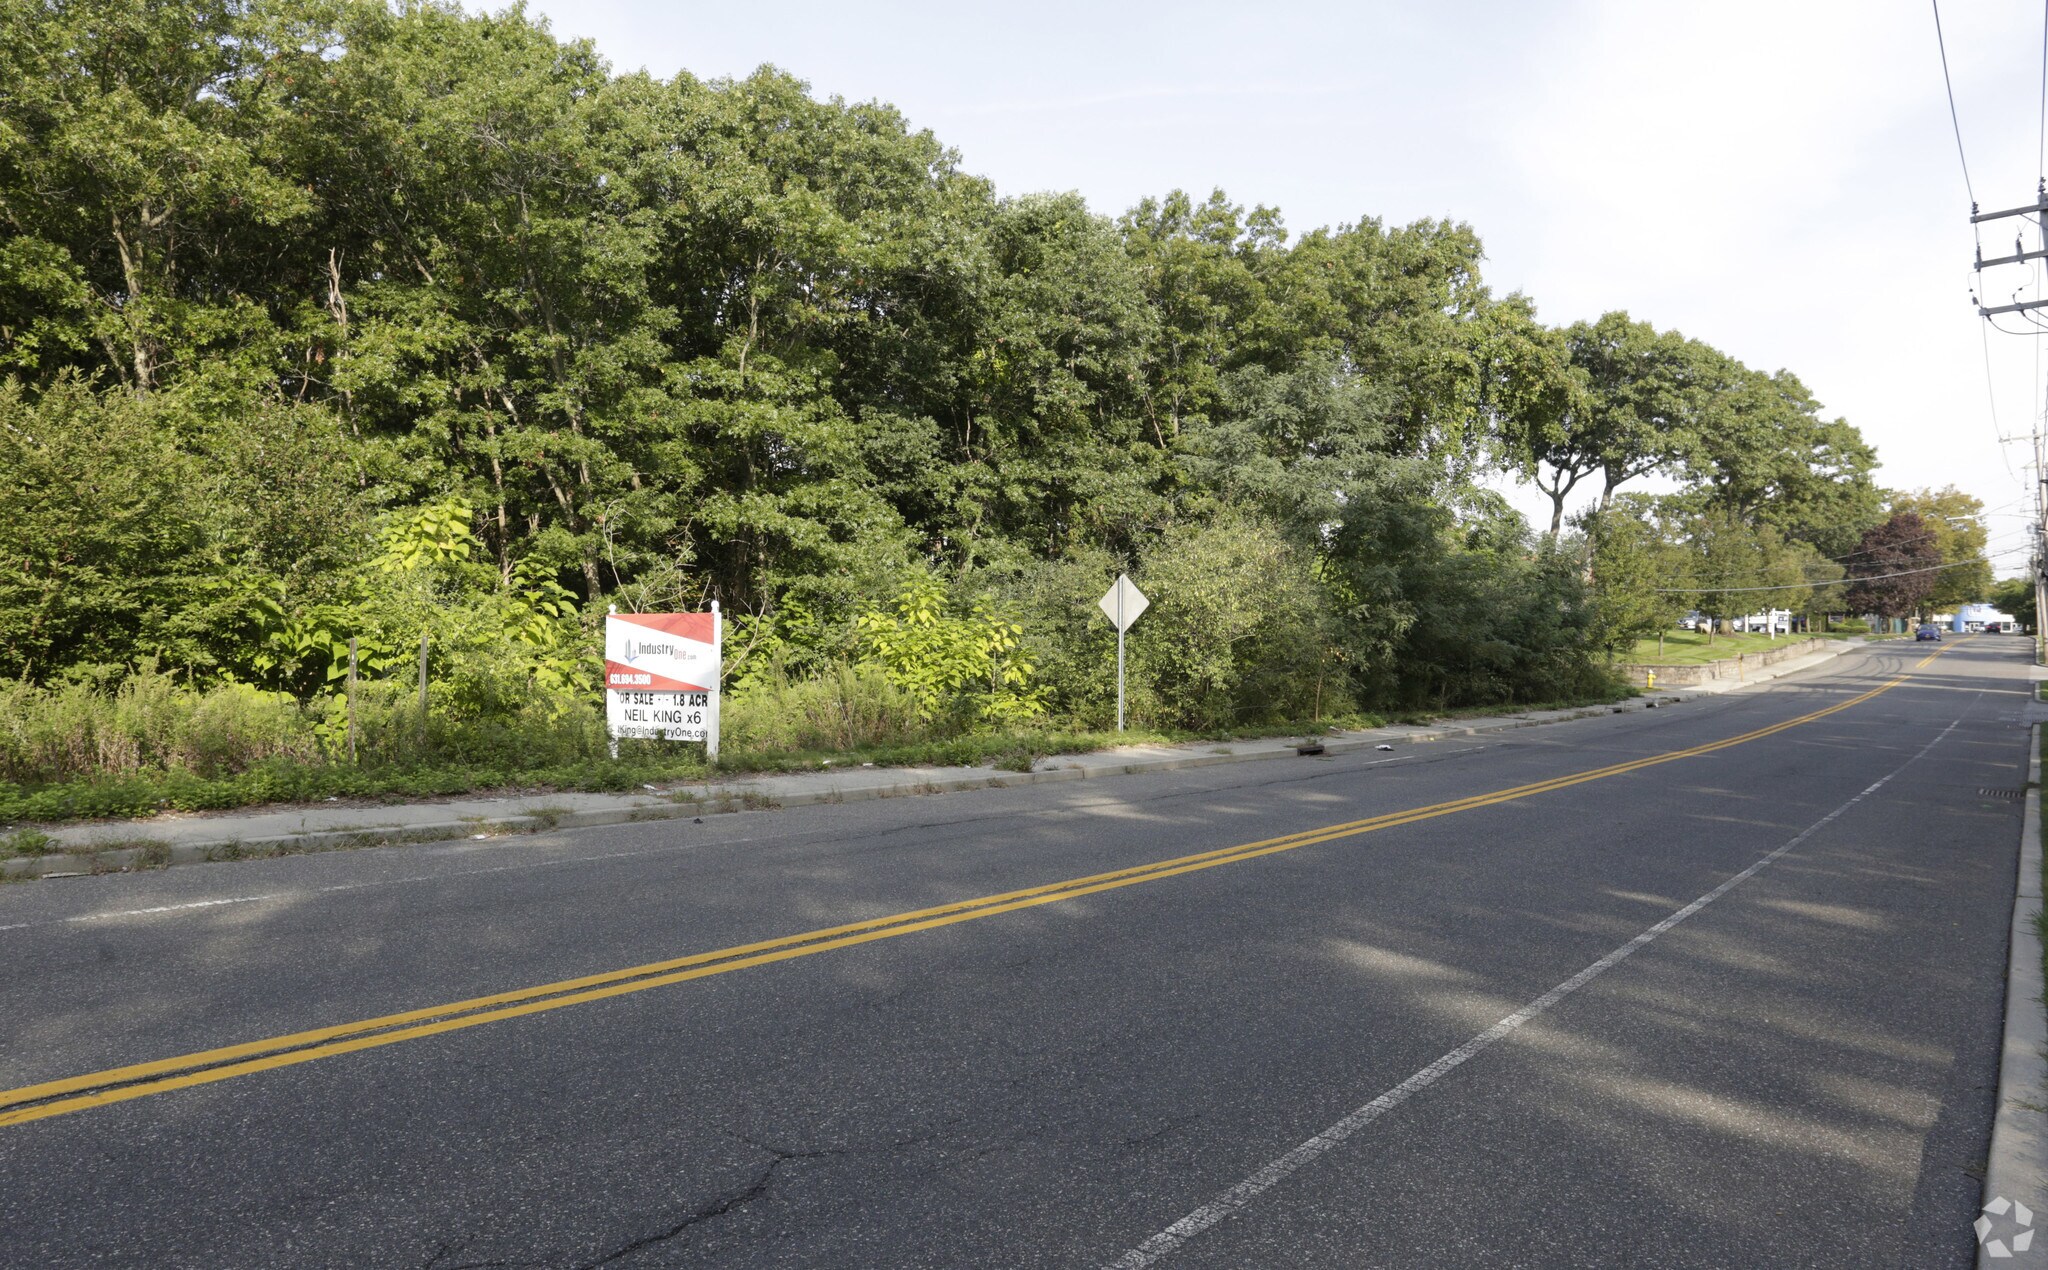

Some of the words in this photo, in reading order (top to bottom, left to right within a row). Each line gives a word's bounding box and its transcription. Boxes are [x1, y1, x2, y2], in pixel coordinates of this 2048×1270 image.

[617, 692, 630, 704] OR
[633, 692, 654, 705] SALE
[673, 693, 685, 706] 1.8
[624, 709, 648, 721] NEIL
[653, 710, 682, 723] KING
[686, 711, 701, 724] x6
